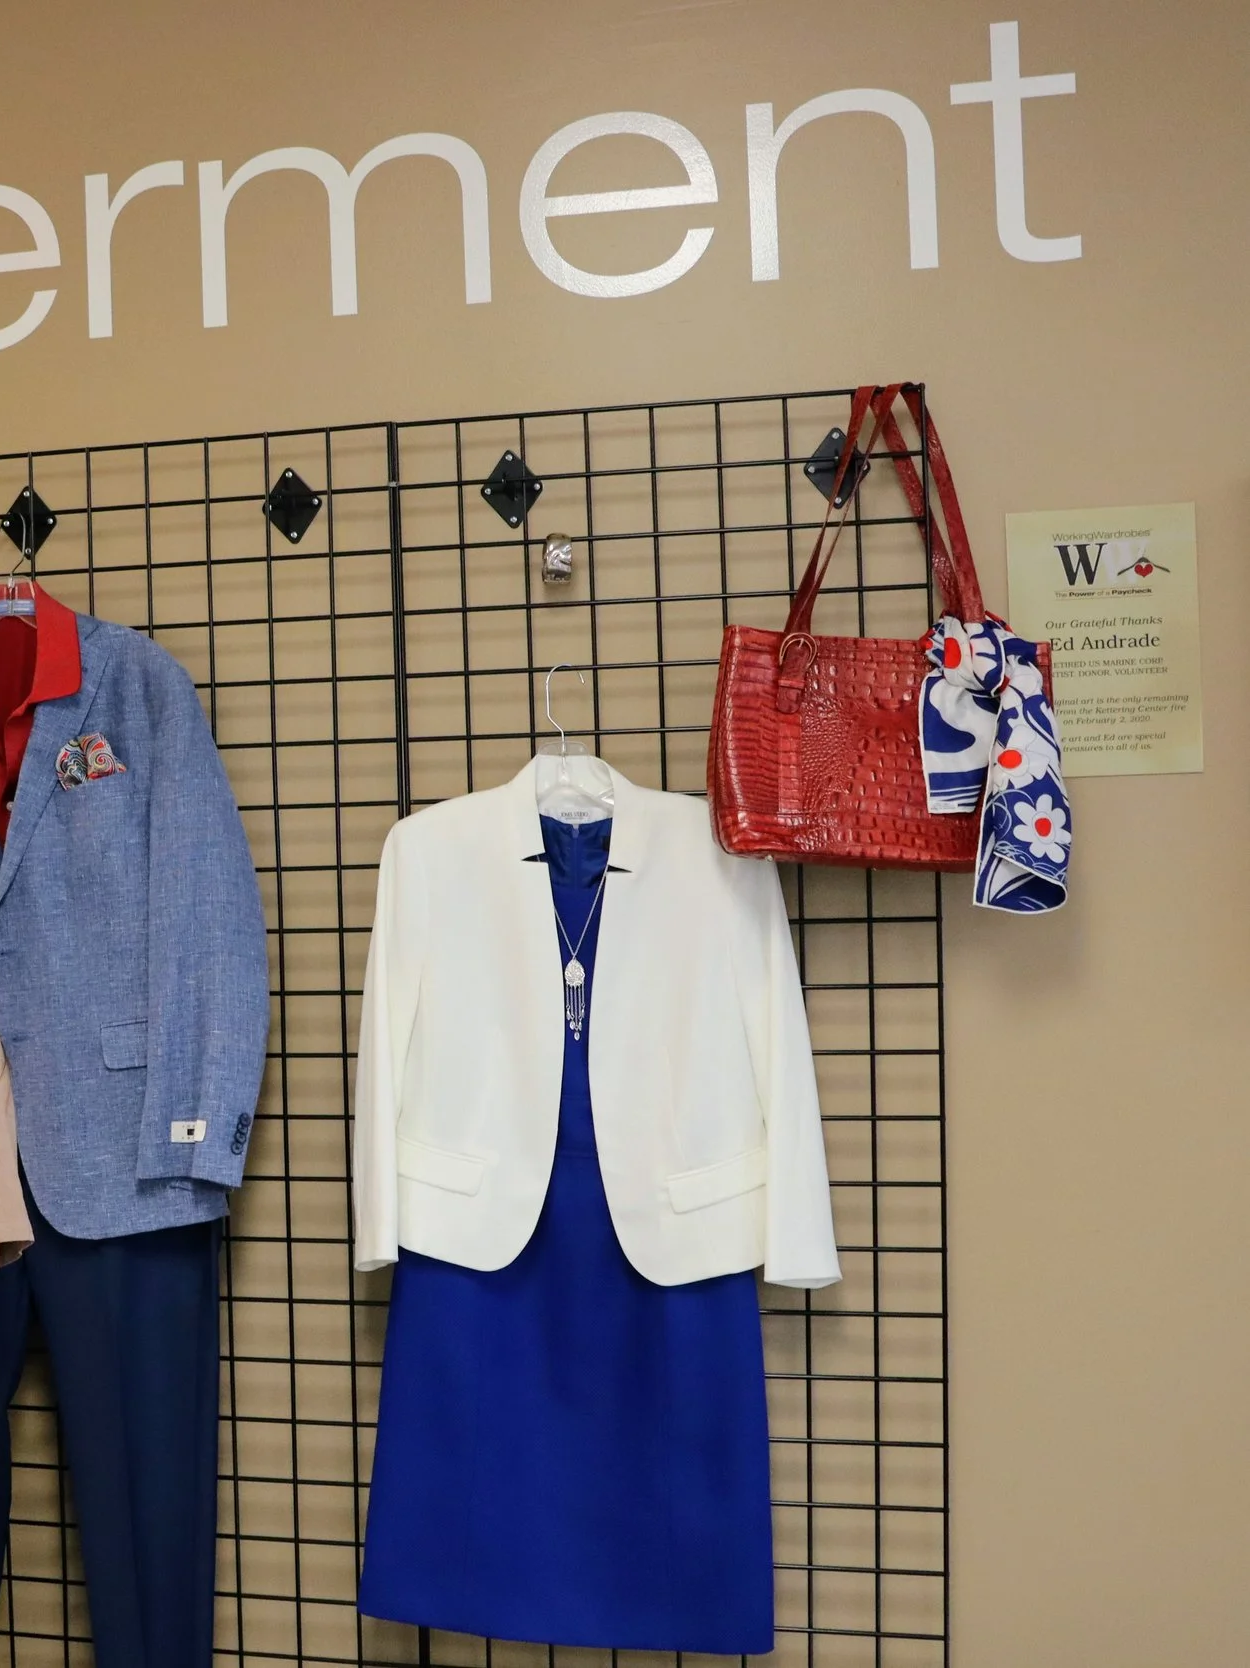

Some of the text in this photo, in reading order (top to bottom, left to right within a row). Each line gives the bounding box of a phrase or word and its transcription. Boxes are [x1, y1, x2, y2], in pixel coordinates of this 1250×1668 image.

[1068, 590, 1096, 598] Power
[1111, 587, 1152, 597] Paycheck
[1045, 615, 1163, 630] Our Grateful Thanks
[1050, 633, 1161, 652] Ed Andrade
[1053, 660, 1087, 669] ETIRED
[1088, 659, 1101, 668] US
[1102, 658, 1137, 667] MARINE
[1114, 666, 1169, 677] VOLUNTEER
[1054, 694, 1190, 707] iginal art is the only remaining
[1055, 703, 1187, 717] from the Kettering Center fire
[1076, 717, 1117, 726] February
[1068, 735, 1082, 743] art
[1083, 734, 1101, 742] and
[1103, 733, 1116, 742] Ed
[1134, 731, 1167, 742] special
[1062, 744, 1103, 753] treasures
[1105, 743, 1114, 752] to
[1116, 743, 1128, 751] all
[1129, 742, 1138, 751] of
